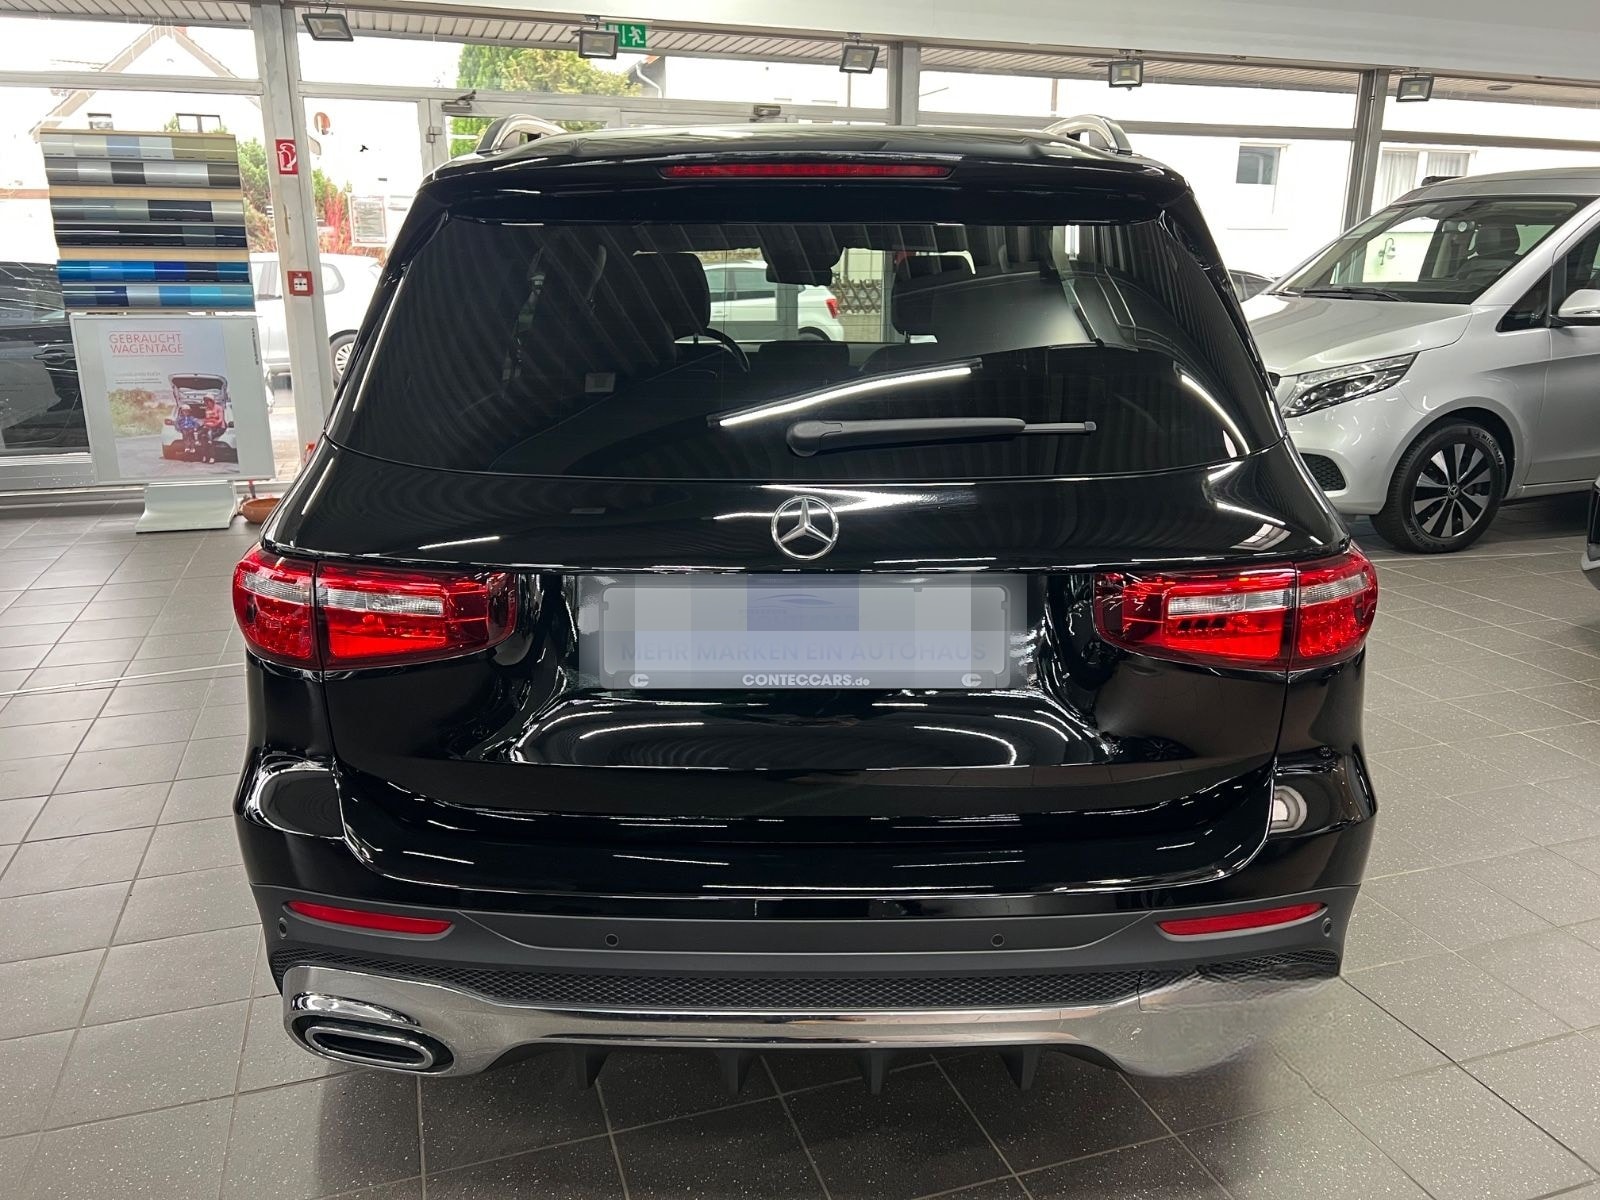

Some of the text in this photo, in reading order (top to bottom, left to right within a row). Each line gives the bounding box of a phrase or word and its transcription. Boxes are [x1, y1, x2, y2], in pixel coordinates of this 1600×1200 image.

[109, 333, 182, 343] GEBRAUCHT
[110, 343, 184, 353] WAGENTAGE
[621, 642, 986, 661] MEHR MARKEN EIN AUTOHAUS
[742, 673, 870, 686] CONTECCARS.de
